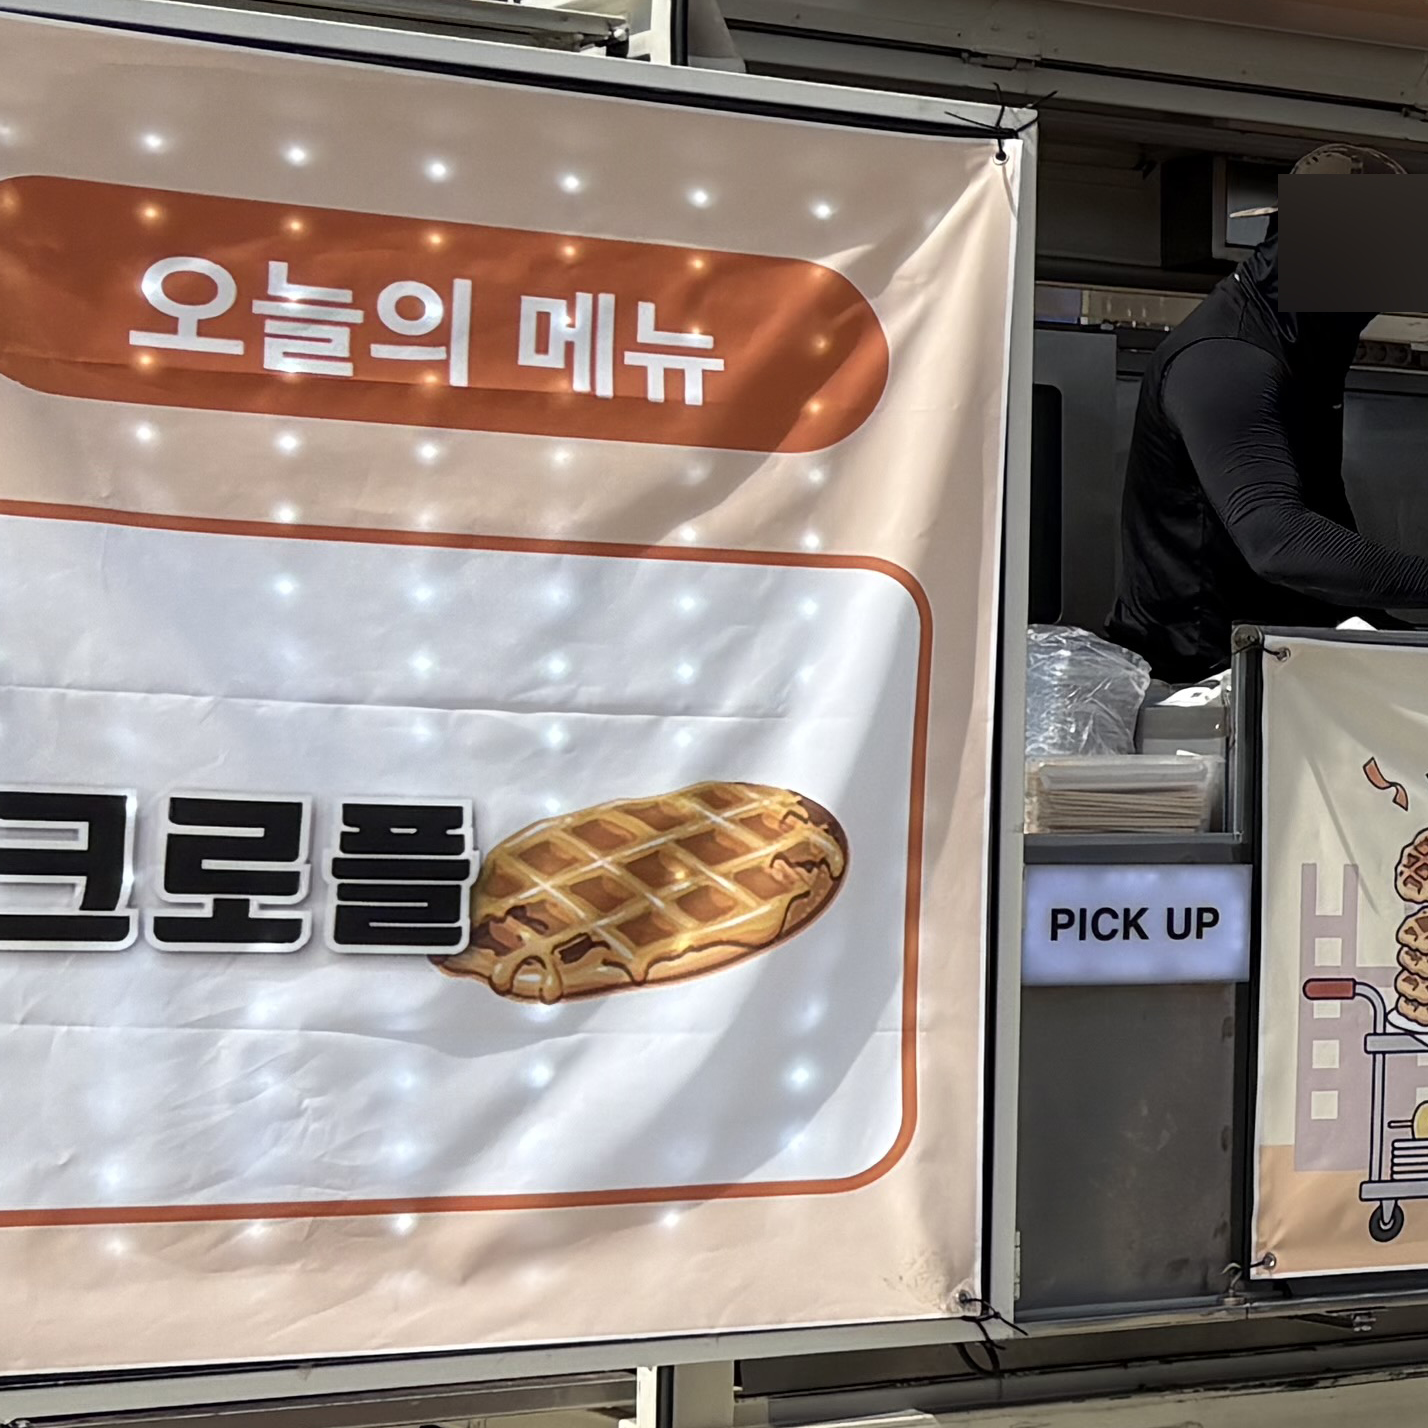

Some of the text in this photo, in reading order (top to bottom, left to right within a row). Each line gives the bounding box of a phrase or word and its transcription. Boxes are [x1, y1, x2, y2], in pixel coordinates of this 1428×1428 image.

[128, 253, 727, 408] 오늘의 메뉴
[0, 789, 473, 949] 크로플
[1049, 906, 1221, 942] PICK UP
